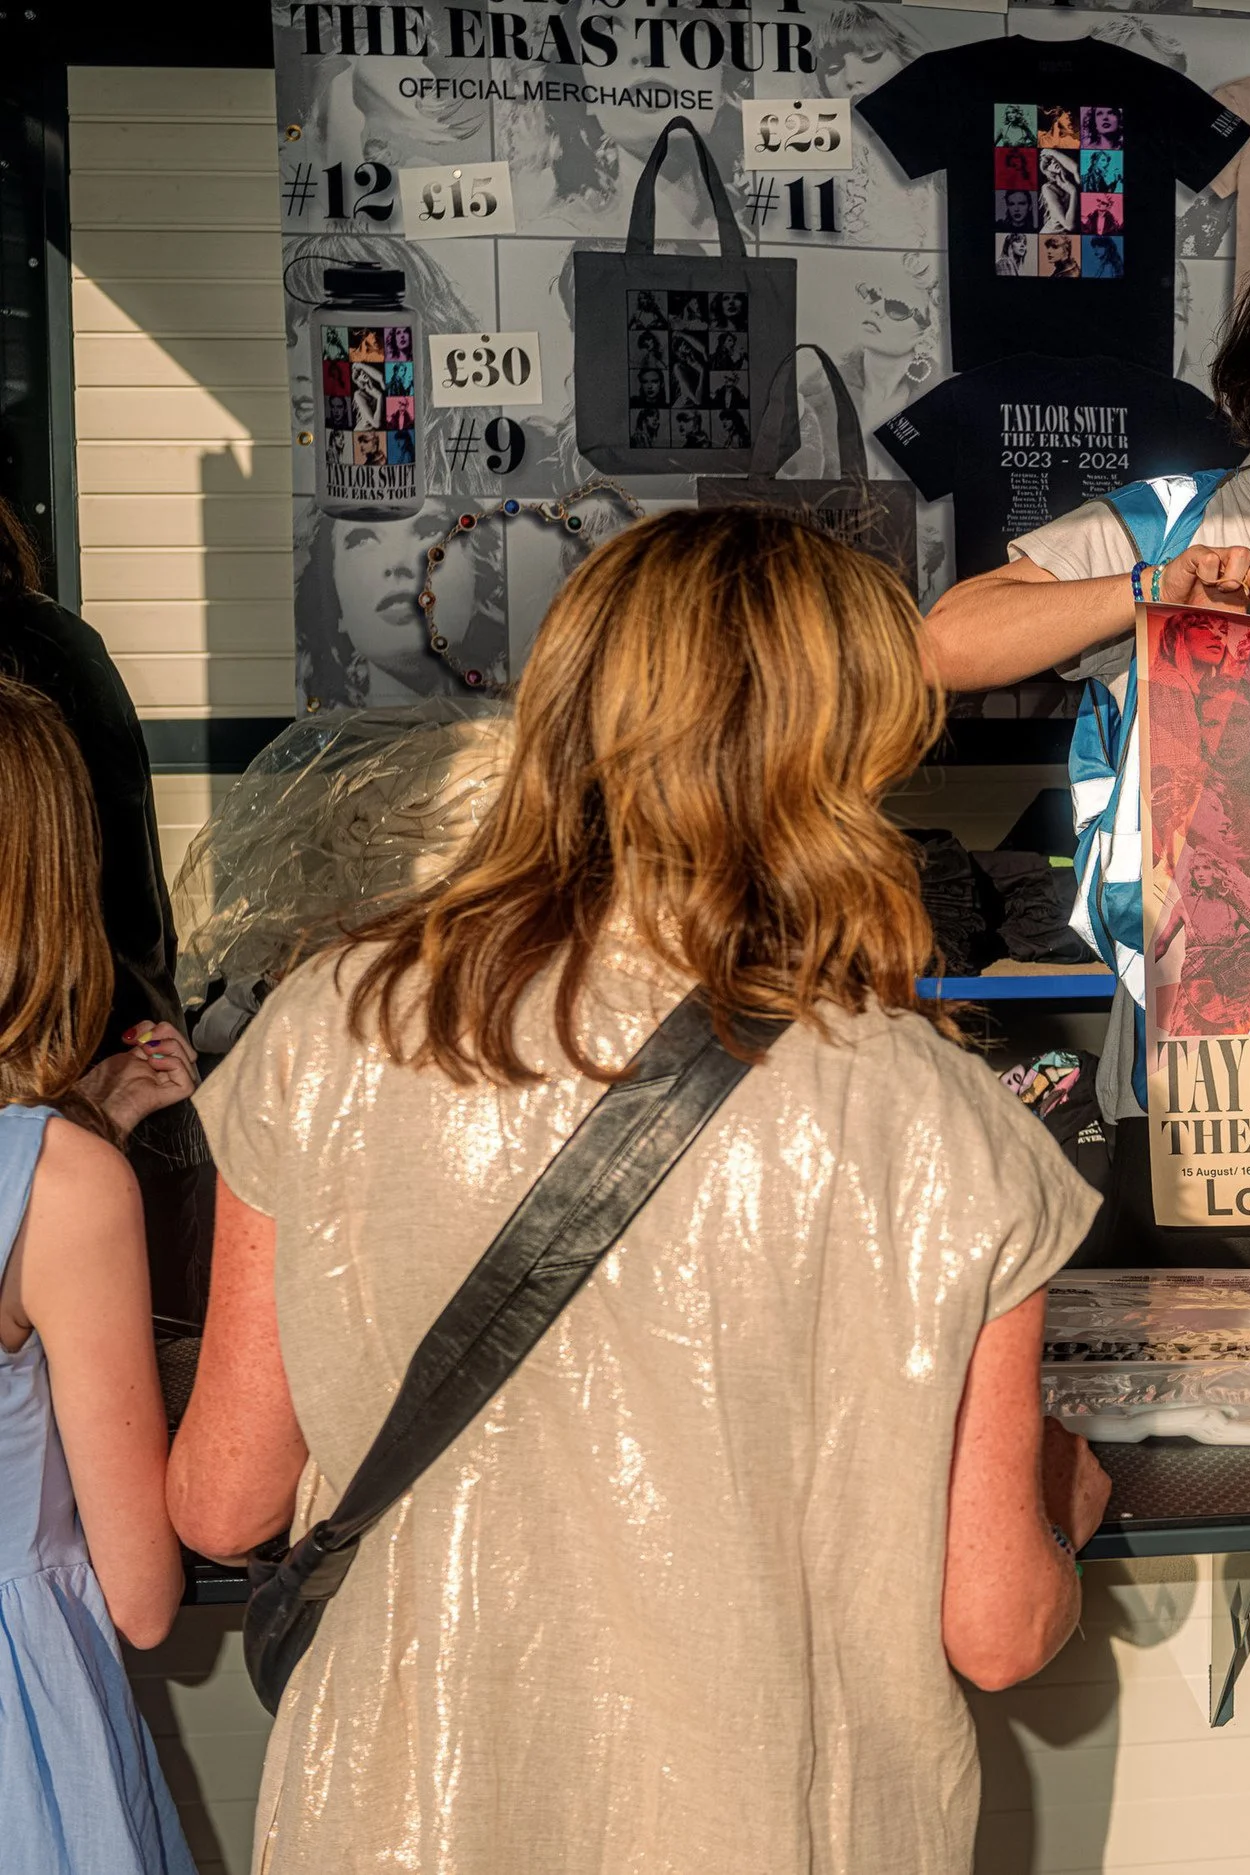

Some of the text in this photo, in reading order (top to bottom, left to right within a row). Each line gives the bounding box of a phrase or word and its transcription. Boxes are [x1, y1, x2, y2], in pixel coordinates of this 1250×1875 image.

[290, 4, 818, 74] THE ERAS TOUR
[399, 77, 714, 111] OFFICIAL MERCHANDISE
[754, 111, 842, 154] £25
[281, 160, 400, 222] #12
[418, 173, 498, 222] £15
[745, 175, 842, 234] #11
[440, 346, 532, 390] £30
[1000, 402, 1129, 435] TAYLOR SWIFT
[445, 415, 527, 475] #9
[1001, 433, 1129, 450] THE ERAS TOUR
[1001, 451, 1052, 468] 2023
[1078, 452, 1130, 470] 2024
[326, 462, 416, 489] TAYLOR SWIFT
[326, 484, 416, 501] THE ERAS TOUR
[1181, 1168, 1193, 1177] 15
[1196, 1166, 1239, 1178] August/
